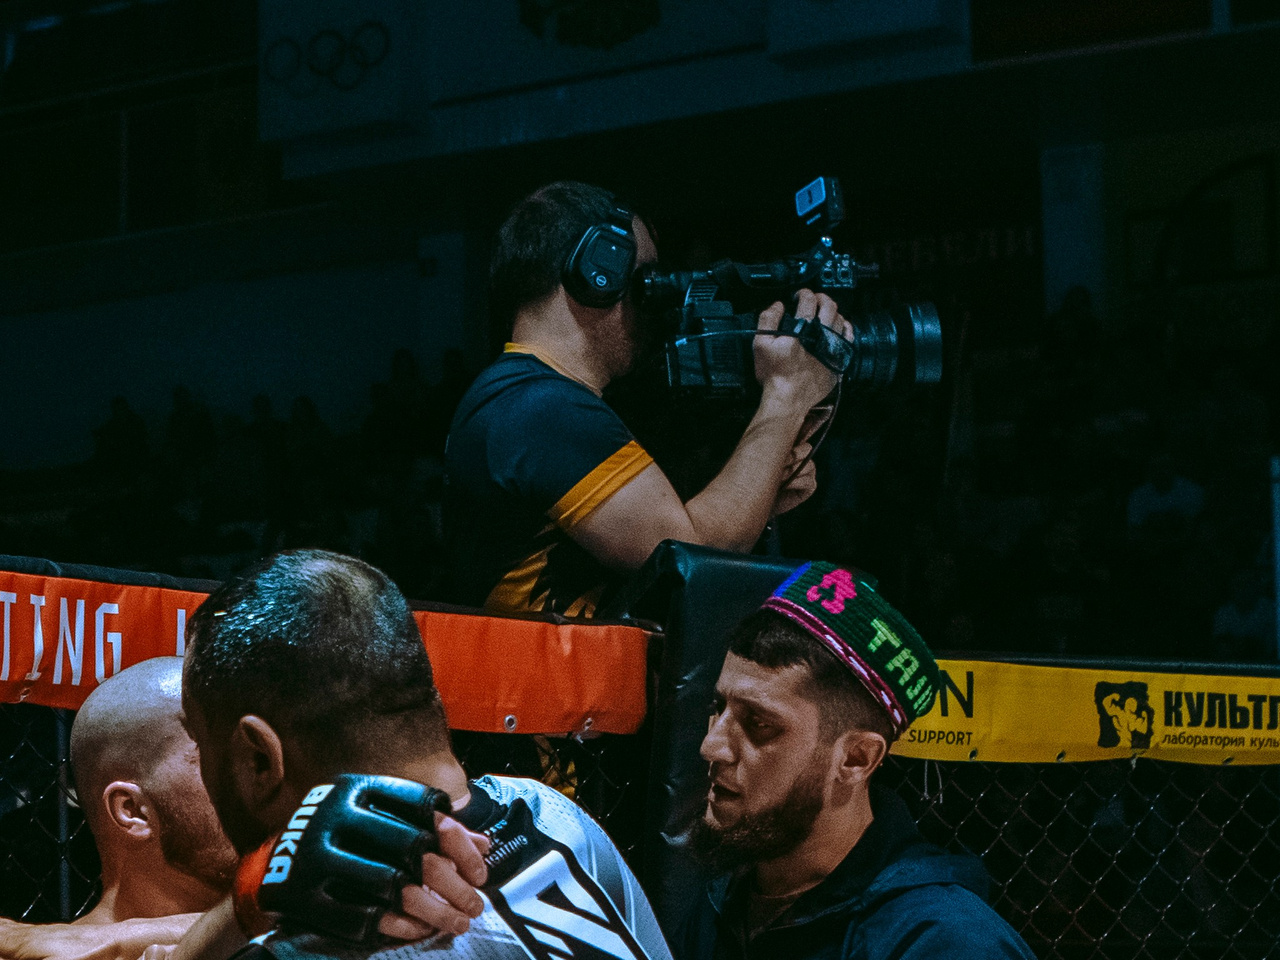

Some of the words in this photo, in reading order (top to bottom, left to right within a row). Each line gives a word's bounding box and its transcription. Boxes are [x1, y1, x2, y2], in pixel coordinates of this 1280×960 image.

[908, 729, 974, 745] SUPPORT
[1161, 732, 1246, 749] лаборатория
[261, 783, 337, 885] BUKA
[484, 834, 529, 868] IGHTING
